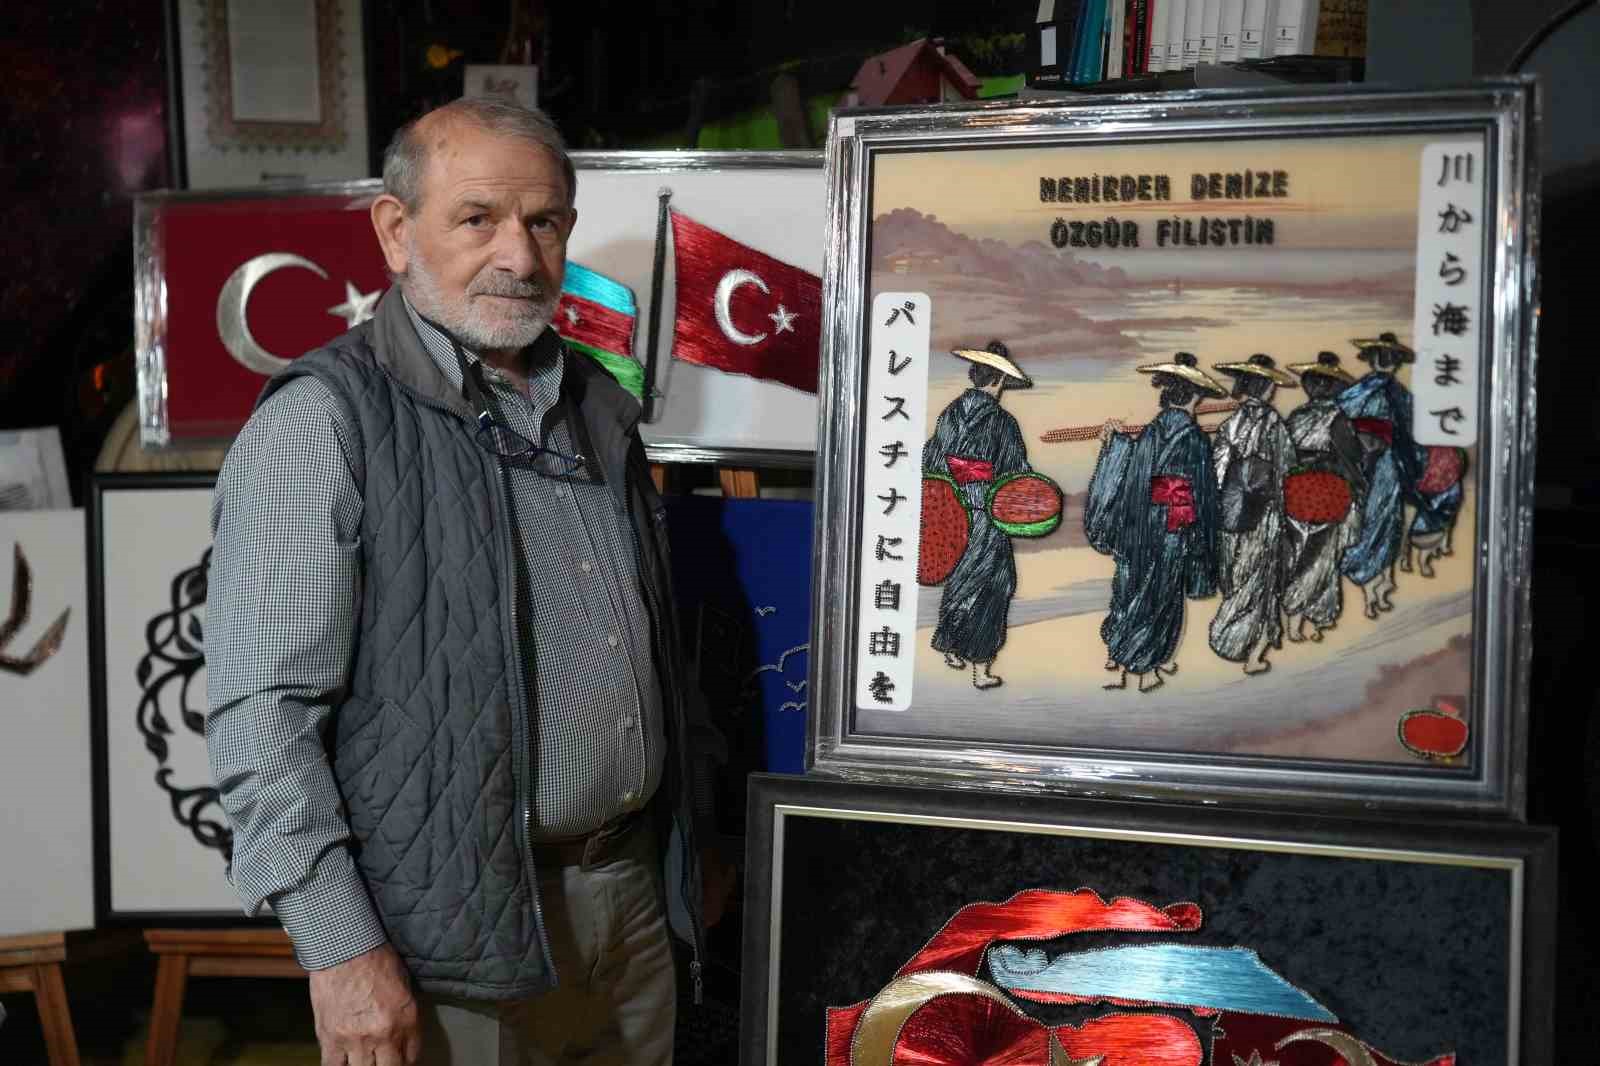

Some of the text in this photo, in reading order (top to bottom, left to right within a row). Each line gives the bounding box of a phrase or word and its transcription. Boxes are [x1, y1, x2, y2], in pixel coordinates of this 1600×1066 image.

[1050, 216, 1139, 249] ÖZGÜR
[1429, 152, 1474, 436] 川から海まで
